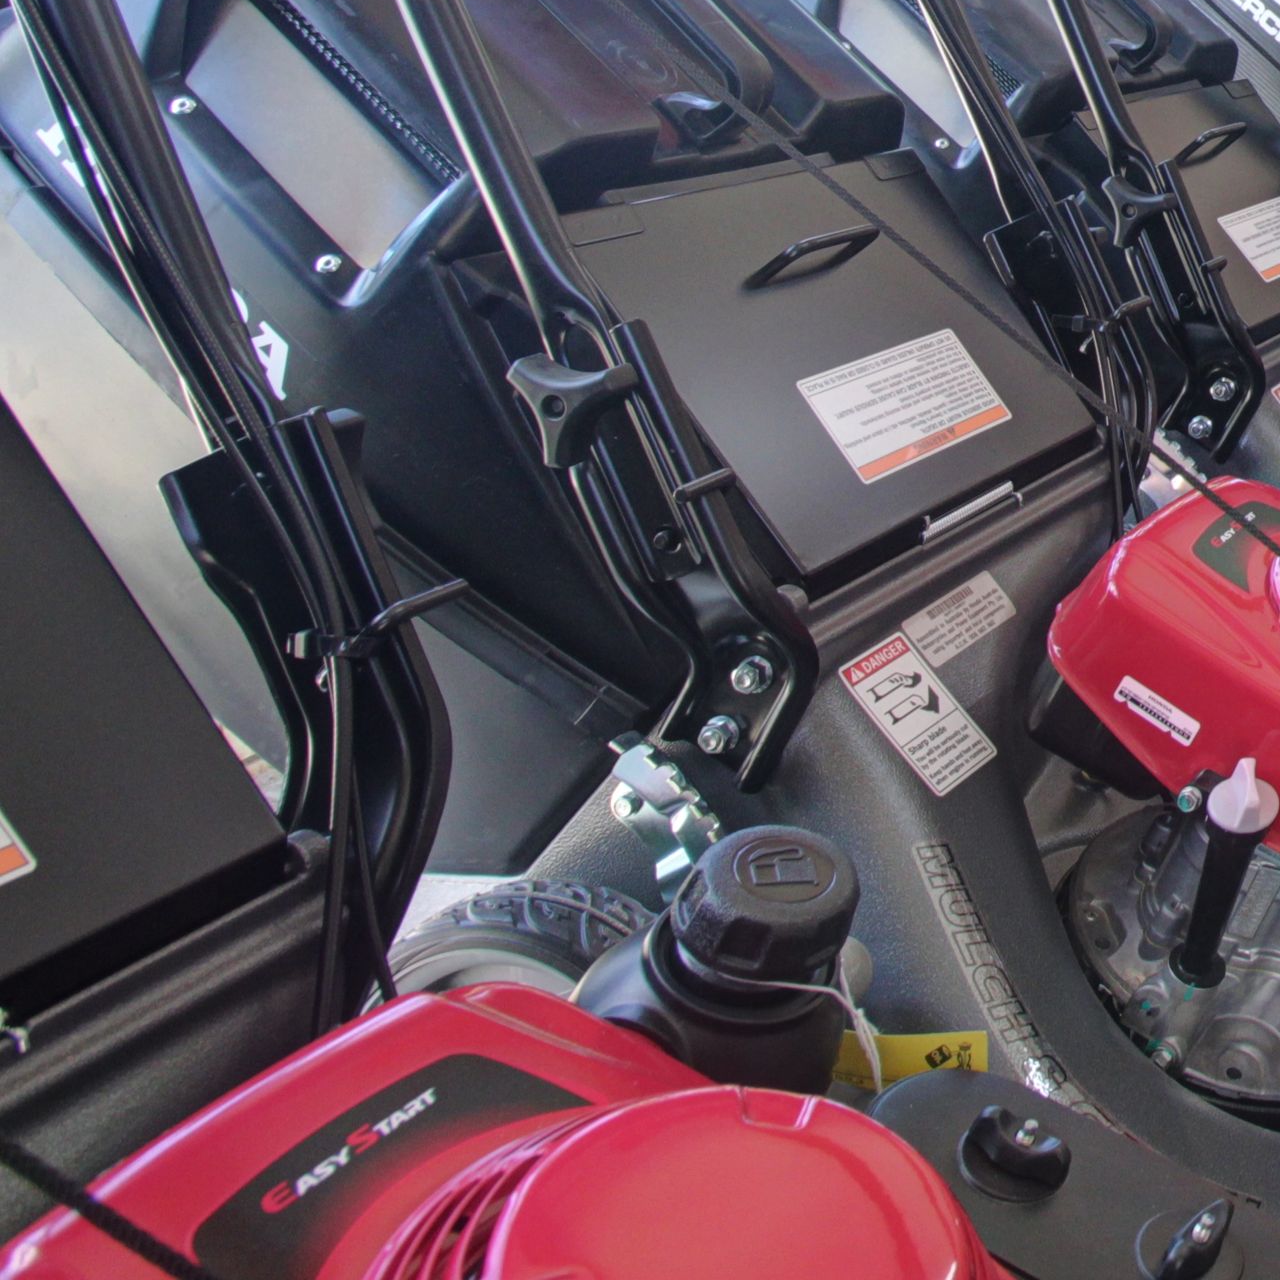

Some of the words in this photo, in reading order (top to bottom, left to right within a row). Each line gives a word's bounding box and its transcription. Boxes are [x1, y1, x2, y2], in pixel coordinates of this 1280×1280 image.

[858, 639, 906, 674] DANGER
[907, 736, 930, 756] Sharp
[926, 723, 948, 742] blade
[914, 751, 929, 765] You
[925, 744, 938, 757] will
[933, 741, 943, 751] be
[939, 727, 962, 746] seriously
[920, 761, 931, 772] by
[927, 755, 939, 766] the
[935, 740, 957, 760] rotating
[928, 767, 944, 782] Keep
[940, 756, 957, 772] hands
[953, 750, 965, 762] and
[968, 735, 983, 749] away
[934, 772, 950, 788] when
[946, 759, 966, 778] engine
[914, 841, 1039, 1045] MULCH
